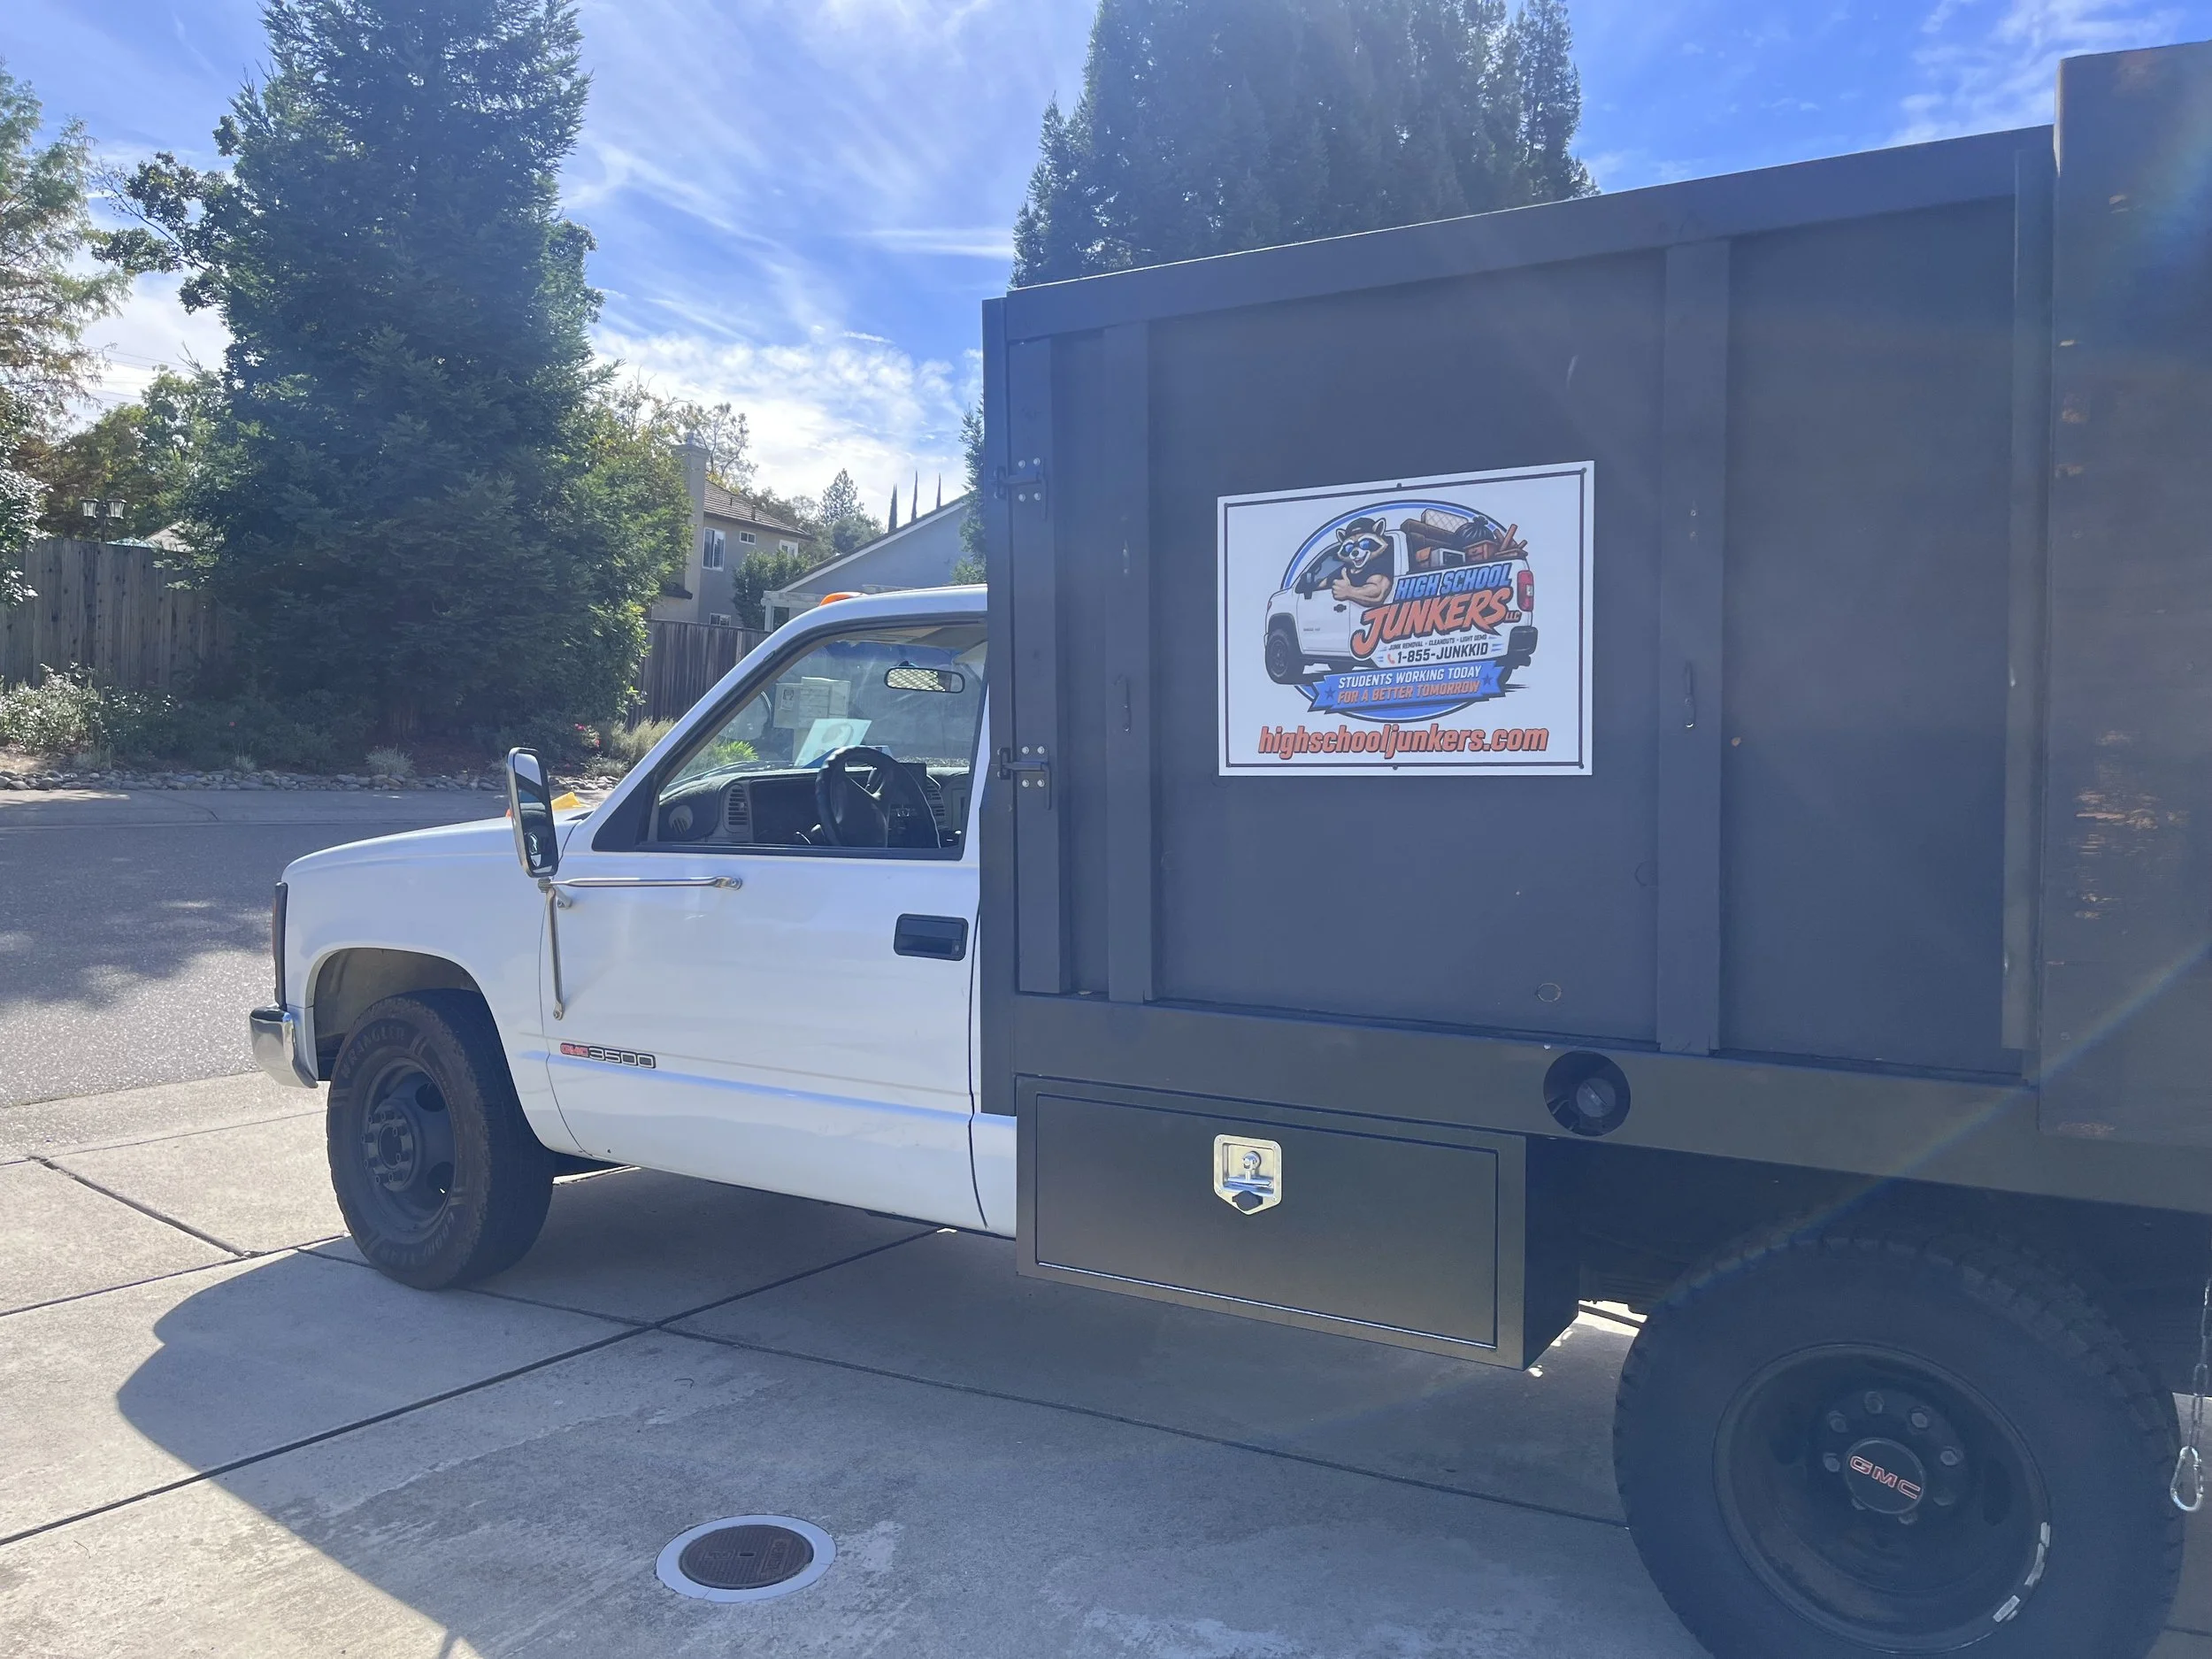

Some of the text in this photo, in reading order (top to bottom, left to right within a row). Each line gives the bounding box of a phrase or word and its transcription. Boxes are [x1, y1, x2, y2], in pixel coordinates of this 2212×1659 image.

[1394, 564, 1512, 601] HIGH SCHOOL
[1353, 587, 1513, 657] JUNKERS
[1505, 611, 1521, 622] LLC
[1398, 642, 1488, 664] 1-855-JUNKKID
[1402, 641, 1424, 650] REMOVAL
[1428, 637, 1455, 647] CLEANOUTS
[1338, 665, 1482, 689] STUDENTS WORKING TODAY
[1337, 680, 1480, 704] FOR A BETTER TOMORROW
[1257, 723, 1549, 760] highschooljunkers.com
[560, 1043, 656, 1069] GMC 3500
[1849, 1455, 1922, 1500] GMC
